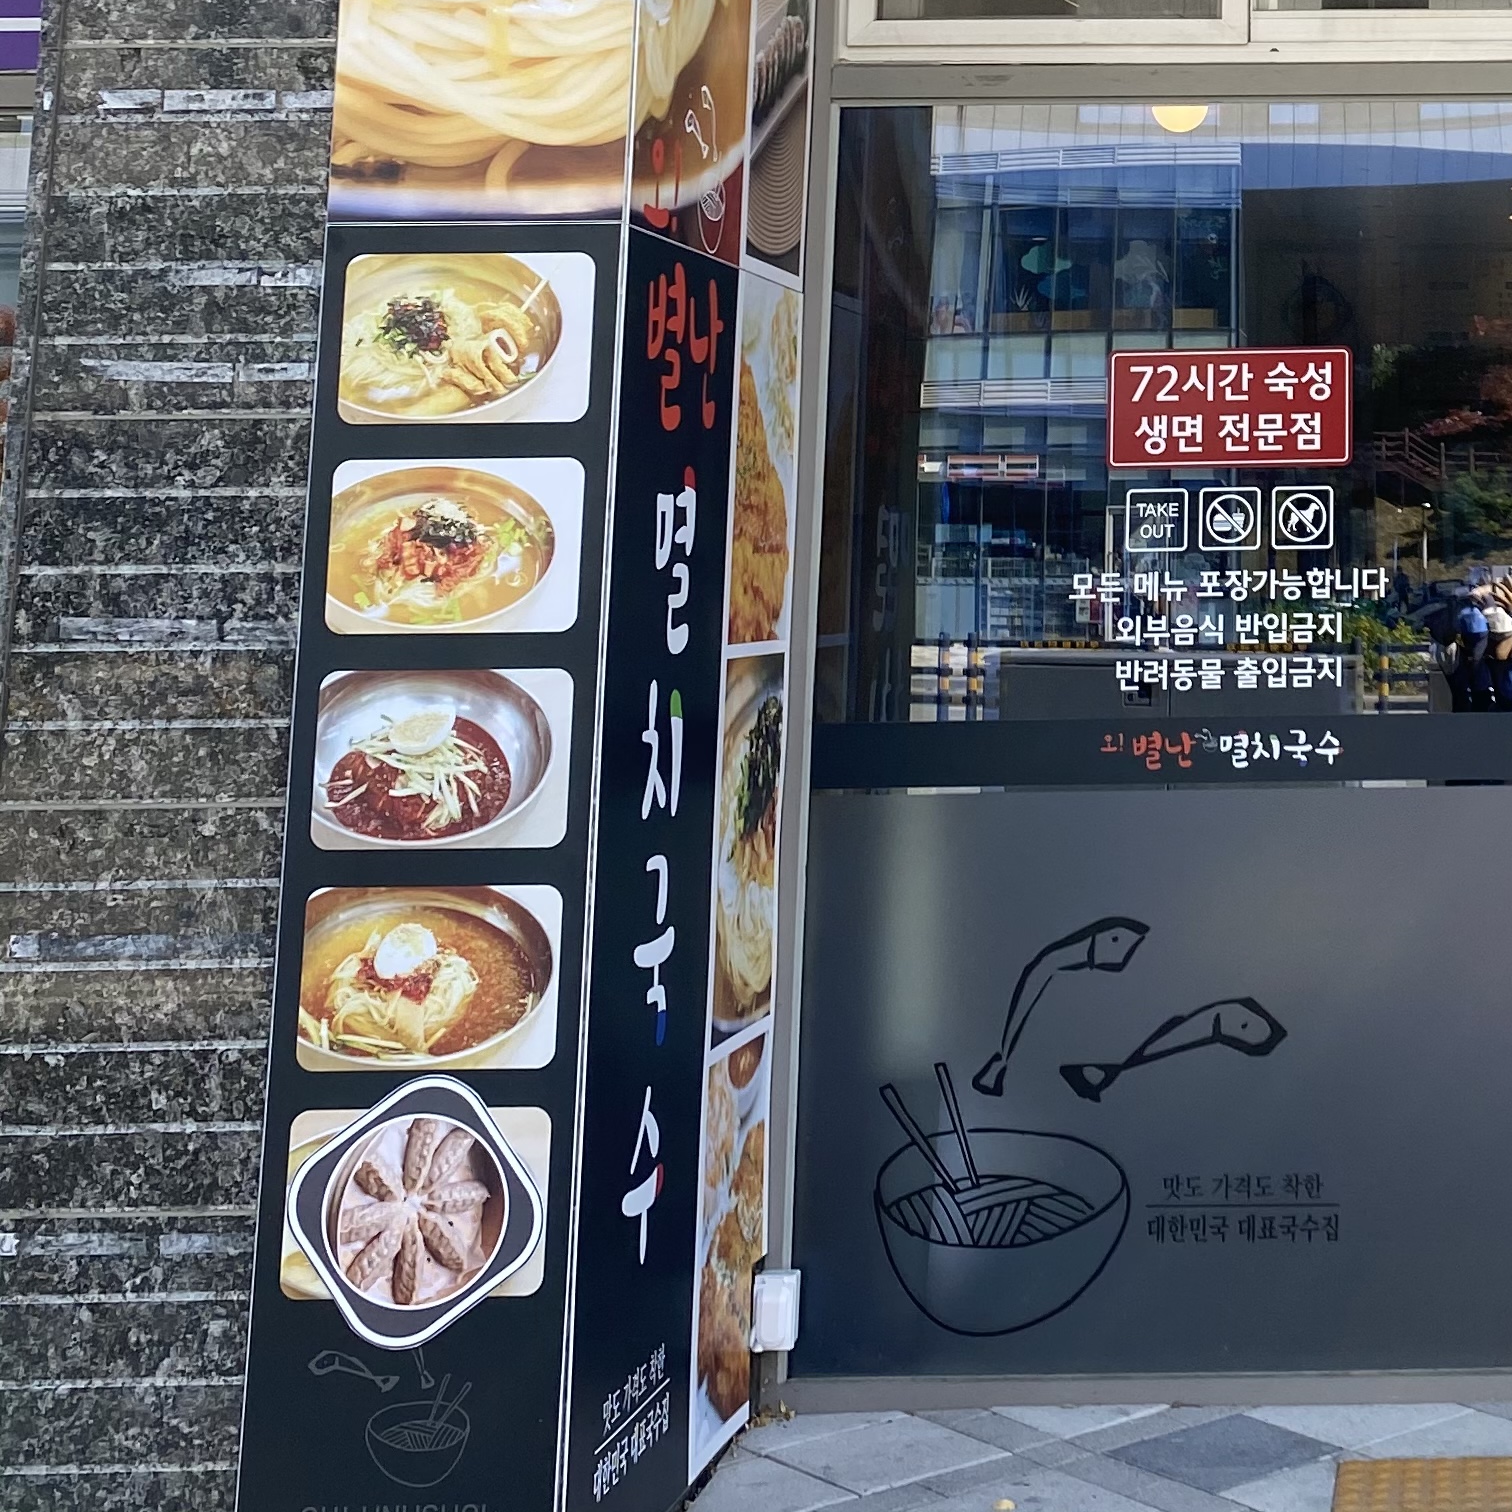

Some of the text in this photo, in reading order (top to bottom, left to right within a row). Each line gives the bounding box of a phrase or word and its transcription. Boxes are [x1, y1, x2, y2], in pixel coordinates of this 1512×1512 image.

[644, 138, 682, 233] 오!
[646, 262, 724, 432] 별난
[1129, 361, 1332, 403] 72시간 숙성
[1135, 412, 1322, 456] 생면 전문점
[1136, 502, 1179, 518] TAKE
[1140, 524, 1175, 539] OUT
[1068, 567, 1389, 603] 모든 메뉴 포장가능합니다
[1115, 612, 1342, 646] 외부음식 반입금지
[1115, 656, 1342, 692] 반려동물 출입금지
[1100, 728, 1345, 771] 오! 별난 멸치국수
[622, 465, 697, 1265] 멸치국수
[1162, 1173, 1325, 1201] 맛도 가격도 착한
[1147, 1214, 1340, 1244] 대한민국 대표국수집
[602, 1343, 665, 1437] 맛도 가격도 착한
[593, 1391, 670, 1504] 대한민국 대표국수집
